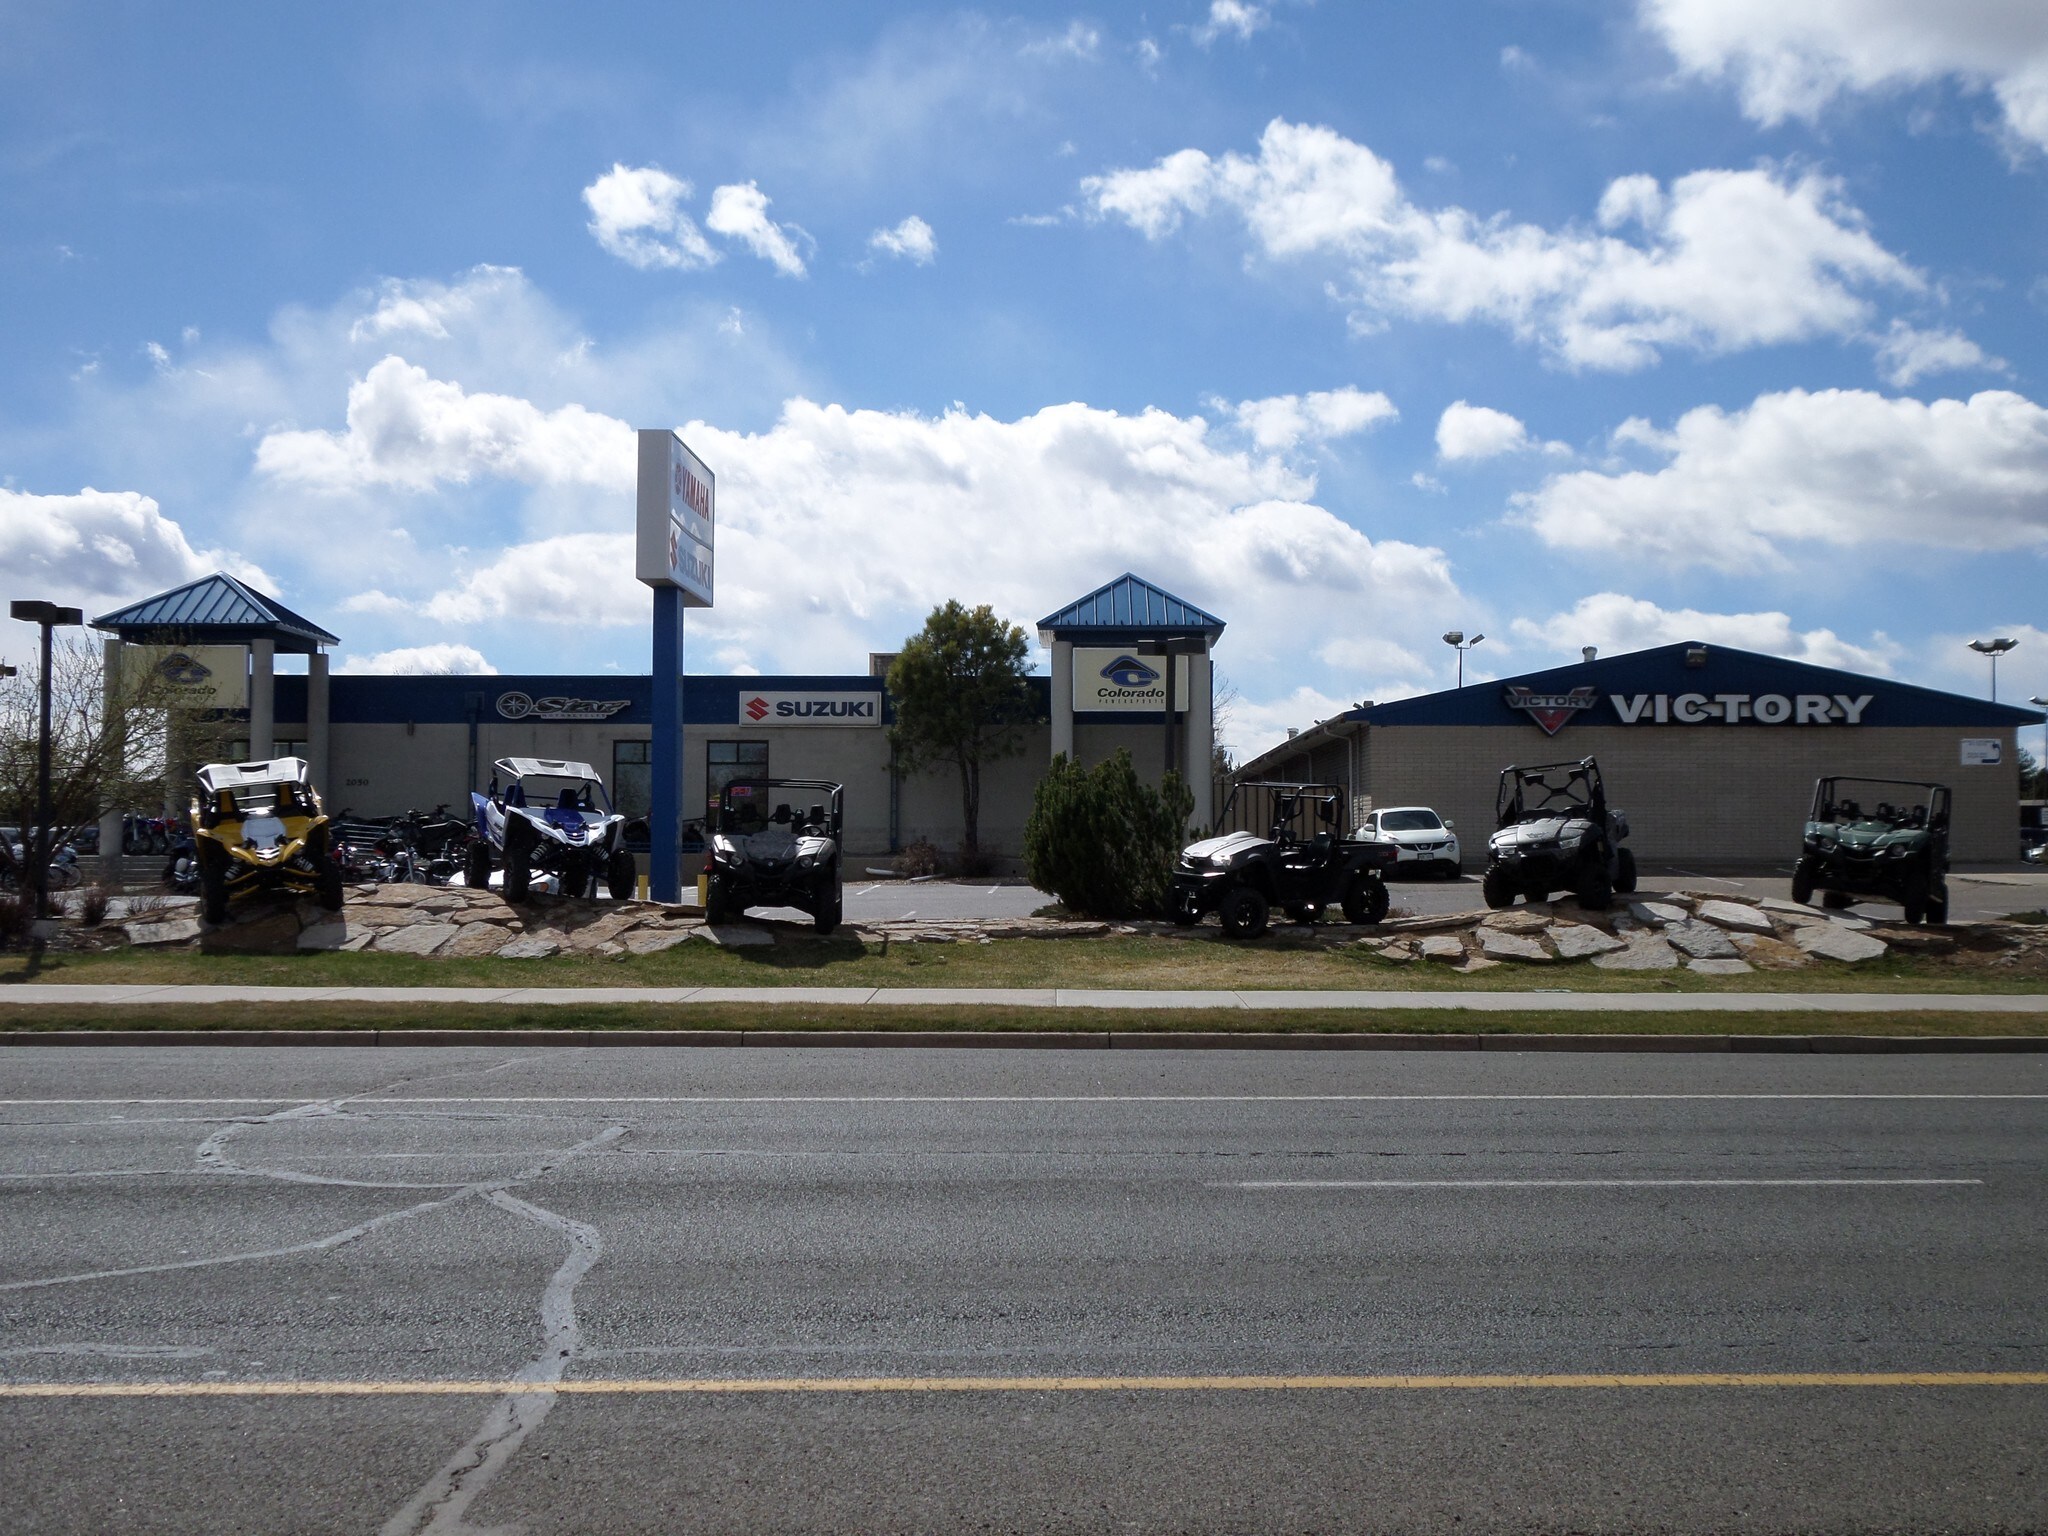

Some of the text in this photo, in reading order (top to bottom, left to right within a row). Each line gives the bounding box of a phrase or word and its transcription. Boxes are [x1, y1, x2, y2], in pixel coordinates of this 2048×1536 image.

[682, 465, 709, 522] YAMAHA
[678, 544, 711, 590] SUZUKI
[1097, 688, 1165, 698] Colorado
[1509, 695, 1595, 706] VICTORY
[775, 701, 874, 717] SUZUKI
[1610, 693, 1874, 724] VICTORY
